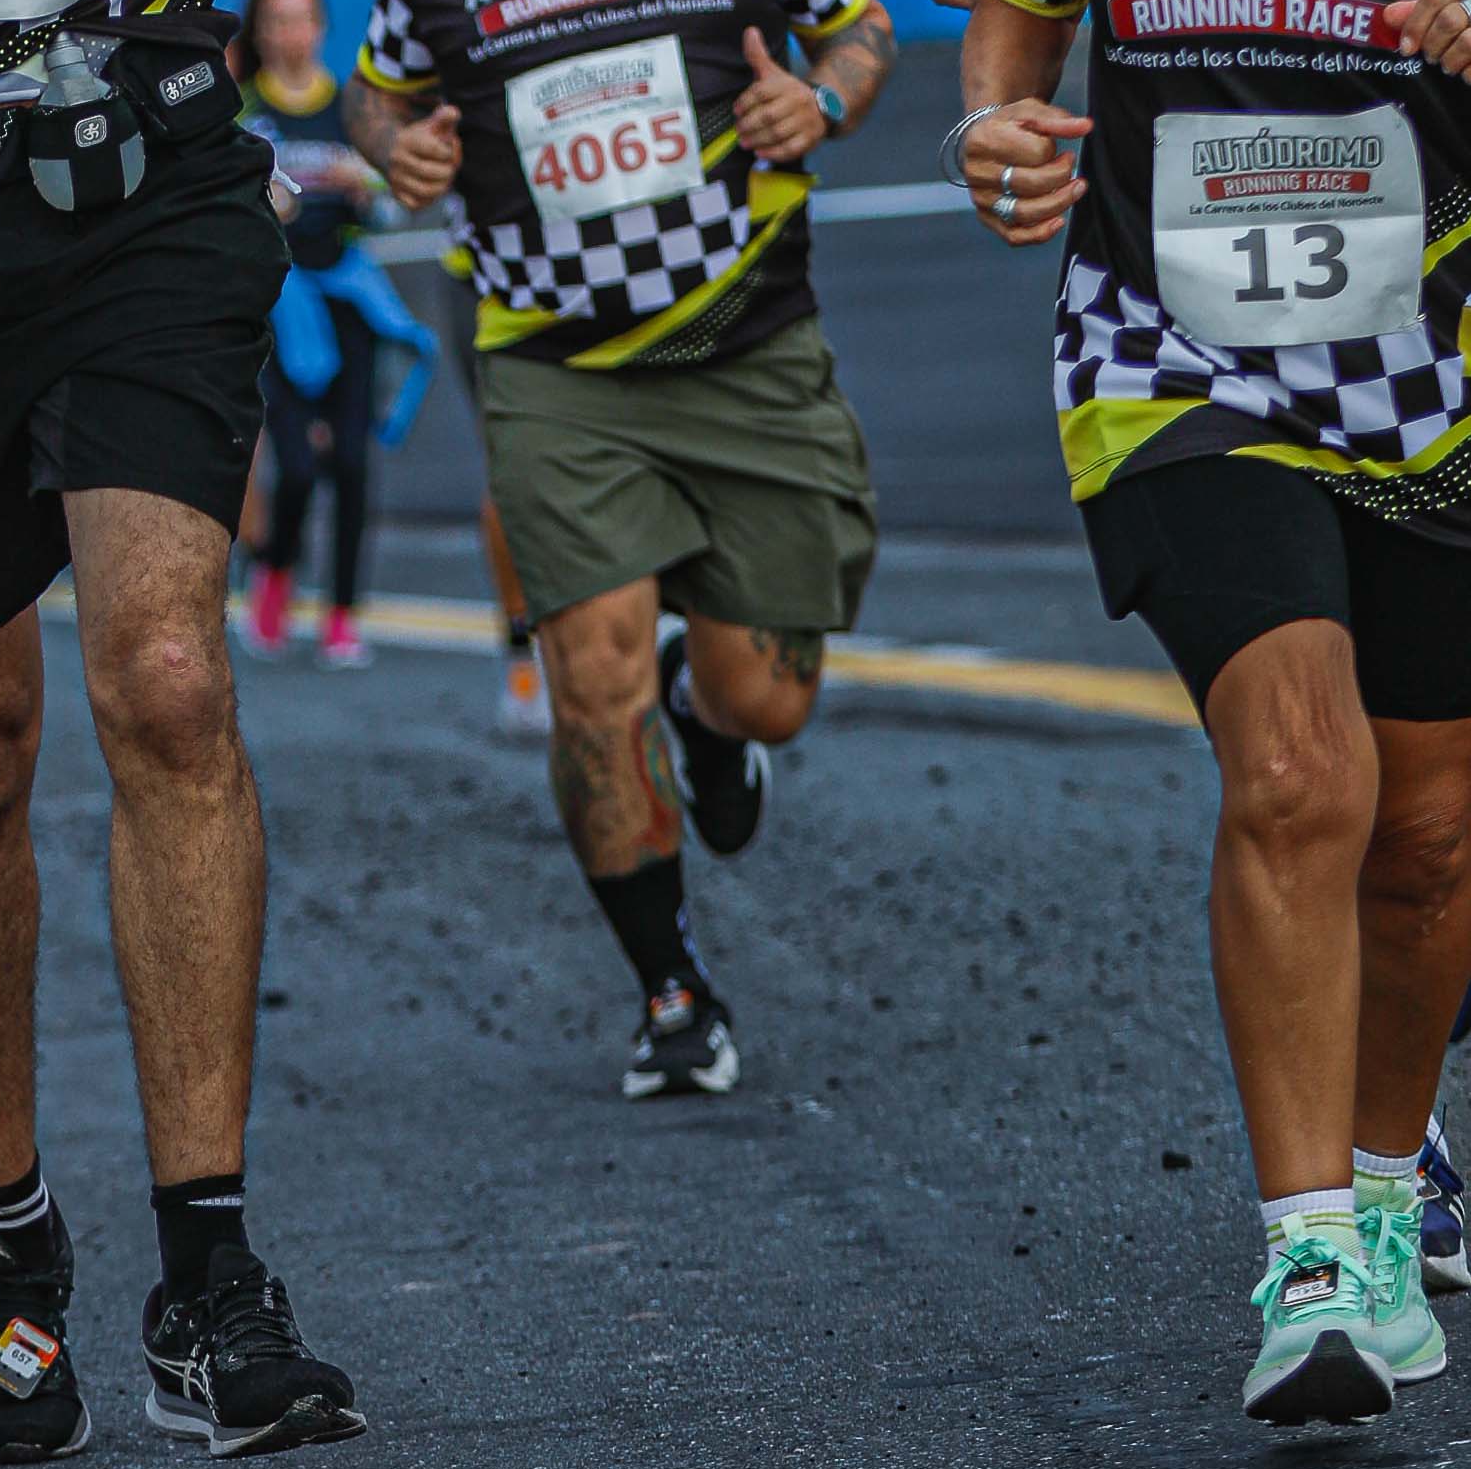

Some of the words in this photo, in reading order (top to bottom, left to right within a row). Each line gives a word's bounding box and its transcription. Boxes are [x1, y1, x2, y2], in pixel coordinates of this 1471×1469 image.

[1174, 47, 1200, 67] de
[1203, 47, 1233, 67] los
[1236, 47, 1307, 68] Clubes
[1311, 51, 1342, 73] del
[1346, 53, 1422, 76] Noroeste
[532, 111, 687, 192] 4065
[1192, 126, 1384, 176] AUTÓDROMO
[1223, 173, 1300, 198] RUNNING
[1305, 173, 1352, 192] RACE
[1232, 223, 1348, 303] 13
[11, 1348, 33, 1365] 657
